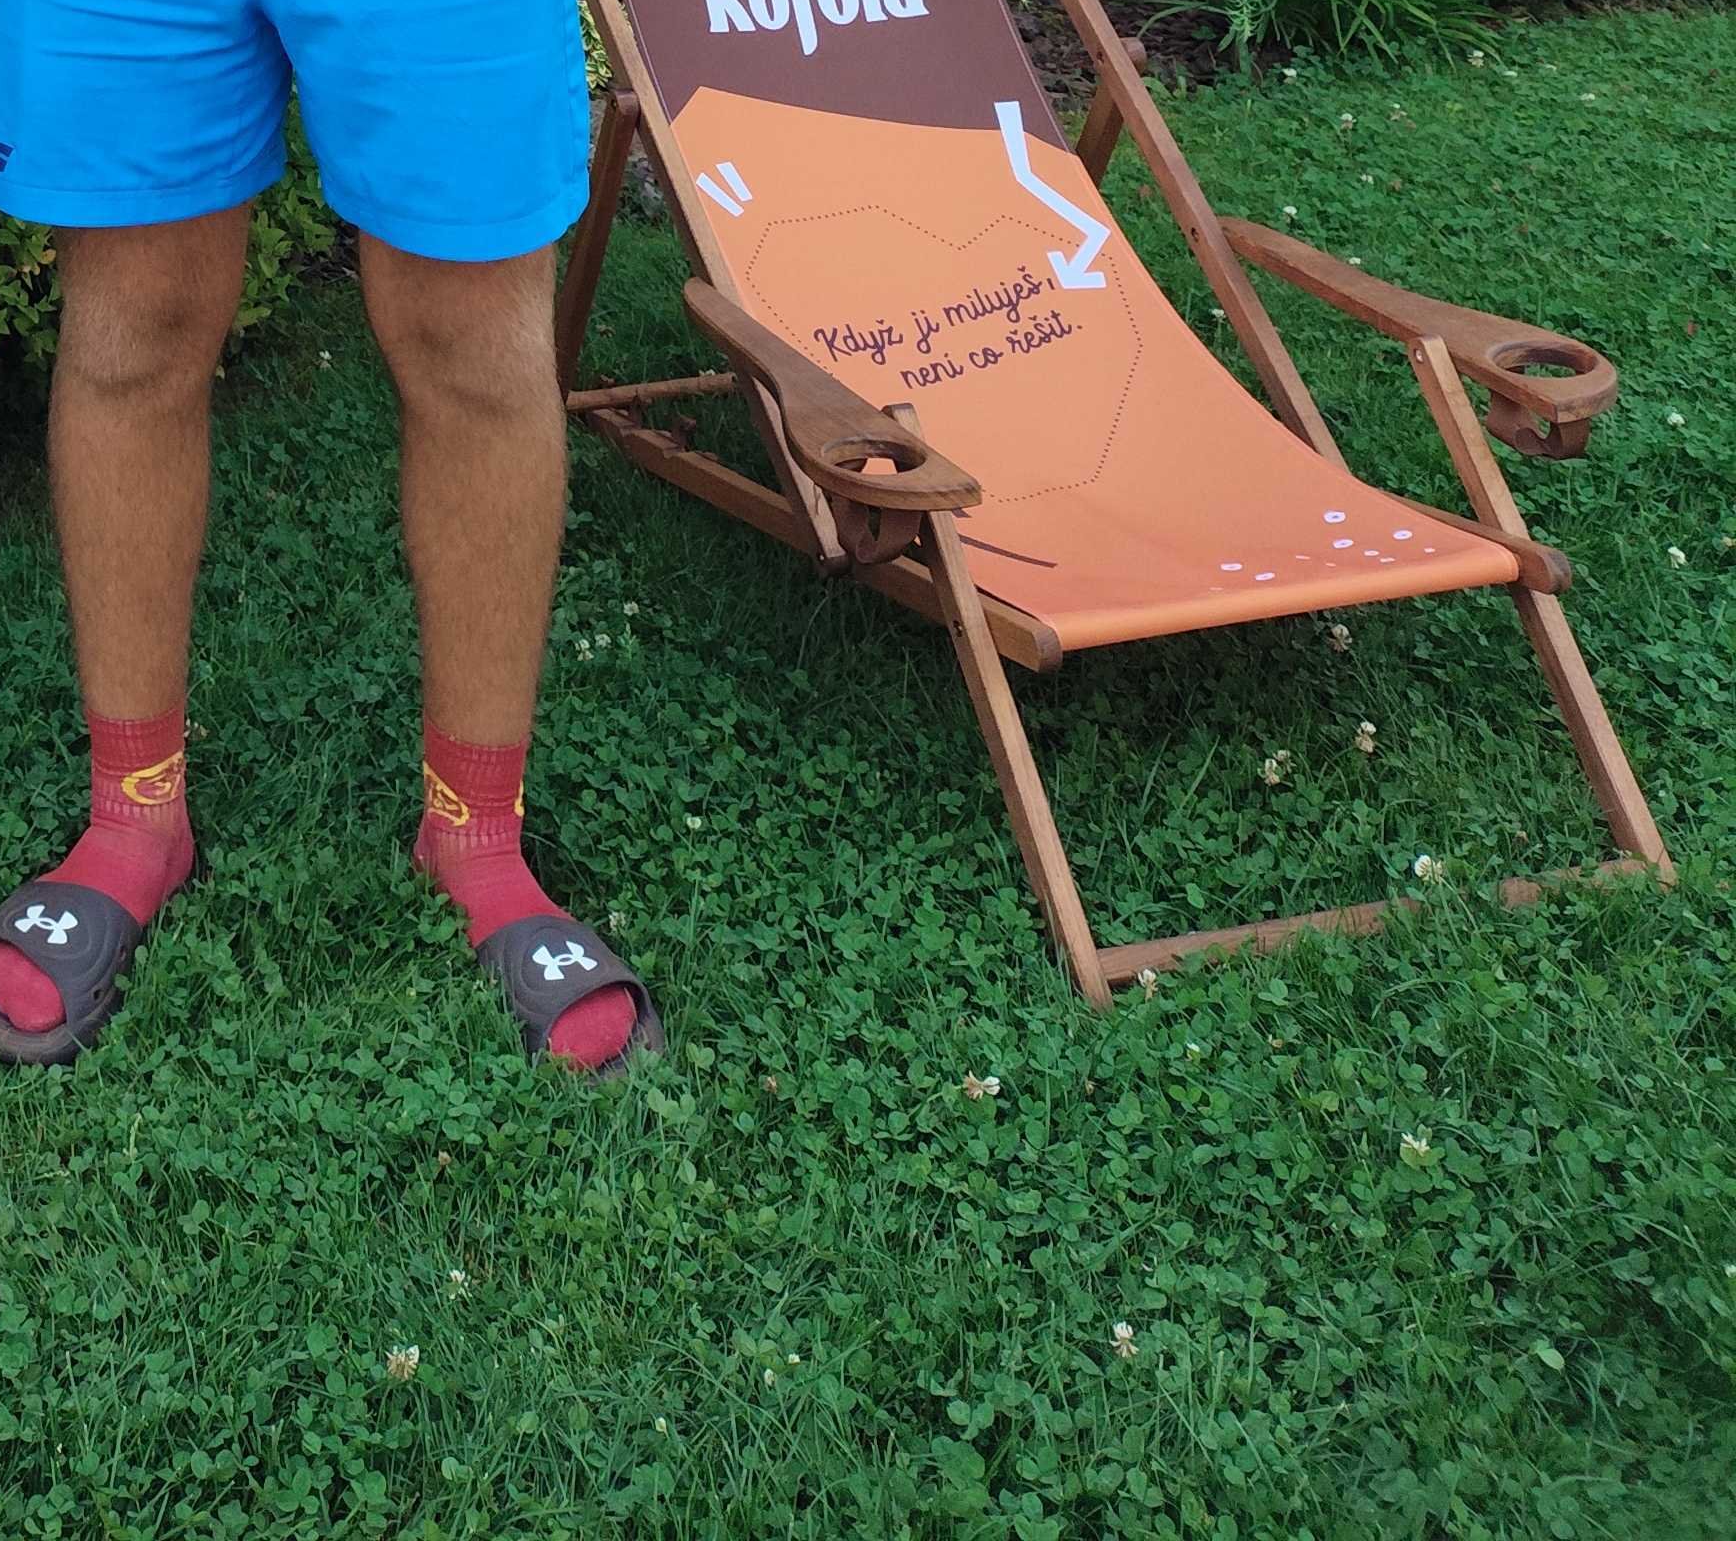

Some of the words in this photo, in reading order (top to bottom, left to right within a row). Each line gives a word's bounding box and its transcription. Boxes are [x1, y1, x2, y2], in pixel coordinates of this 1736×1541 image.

[814, 318, 904, 366] Když
[911, 310, 940, 354] ji
[943, 265, 1056, 324] miluješ,
[968, 346, 1004, 369] co
